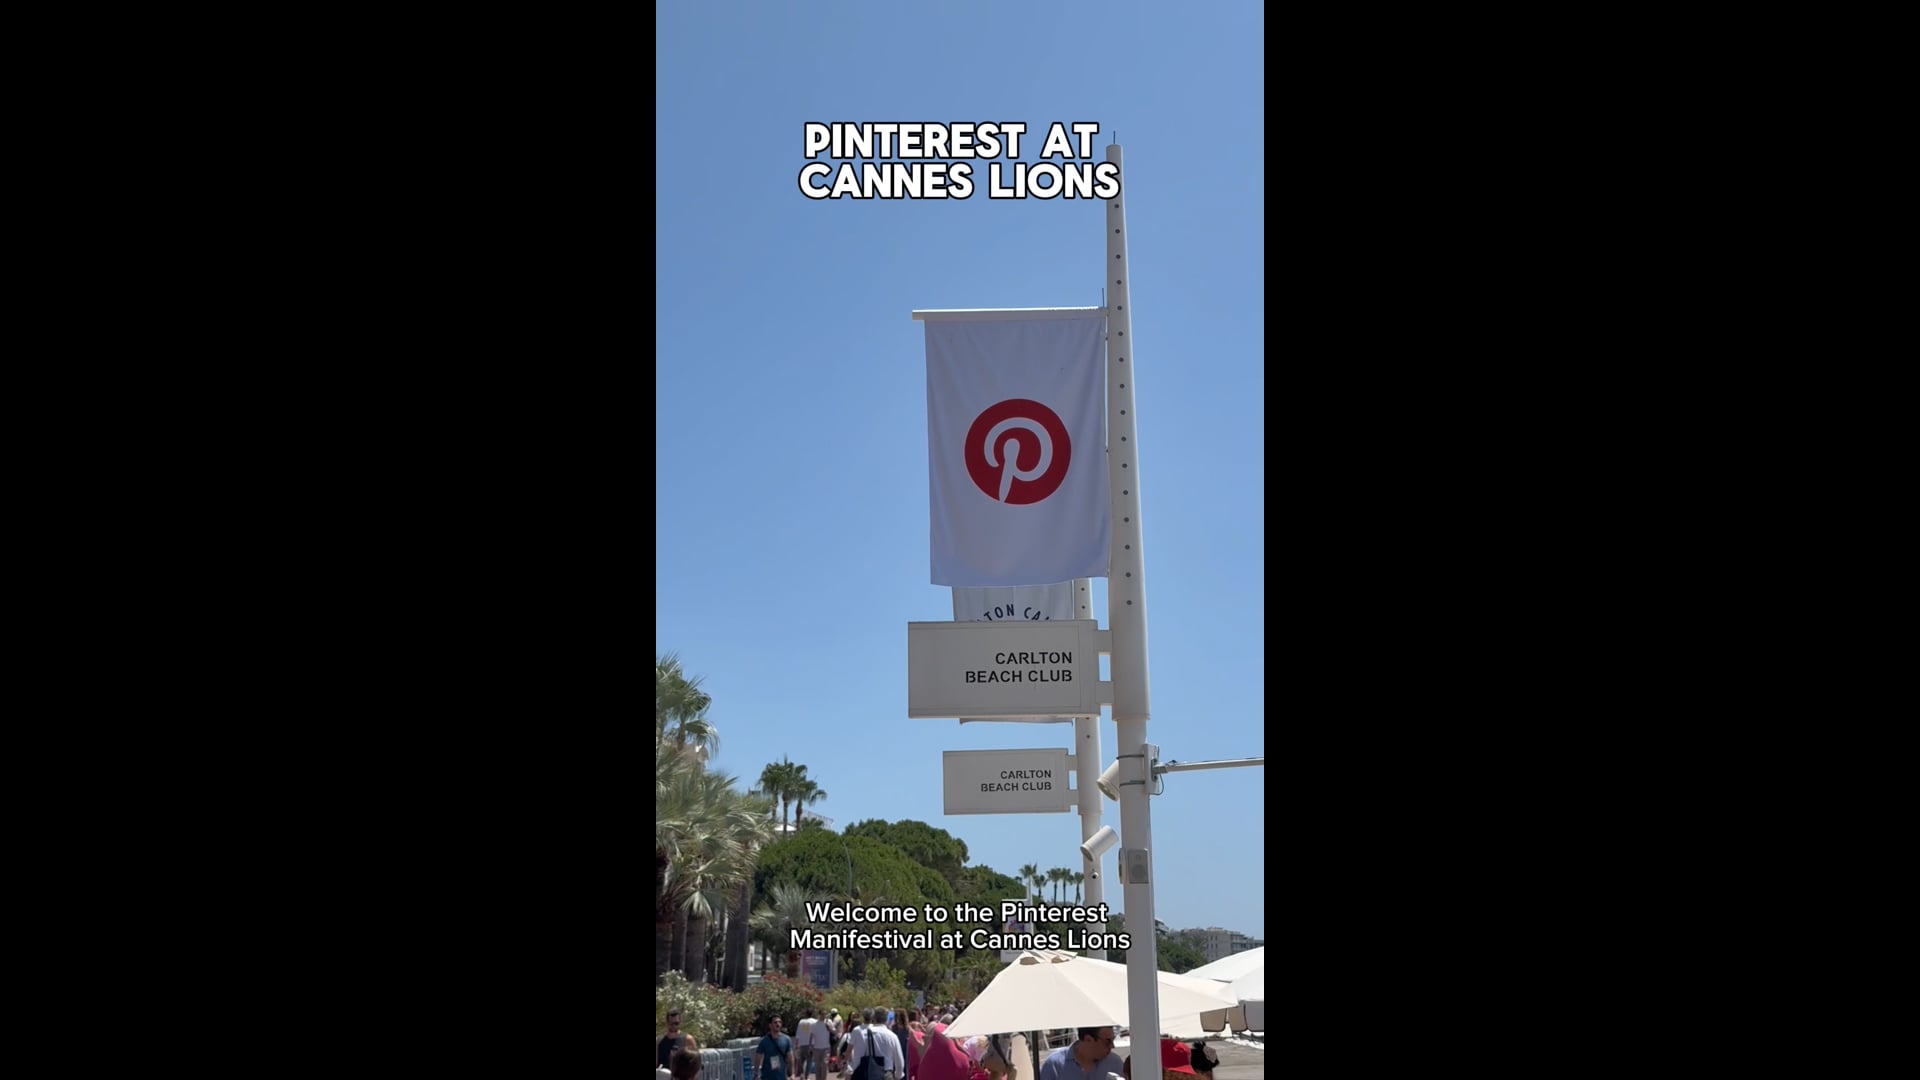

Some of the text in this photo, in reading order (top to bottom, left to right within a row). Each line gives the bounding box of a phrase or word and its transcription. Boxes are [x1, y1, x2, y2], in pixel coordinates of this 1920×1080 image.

[995, 651, 1073, 665] CARLTON
[965, 669, 1073, 684] BEACH CLUB
[1000, 769, 1052, 780] CARLTON
[980, 780, 1052, 793] BEACH CLUB
